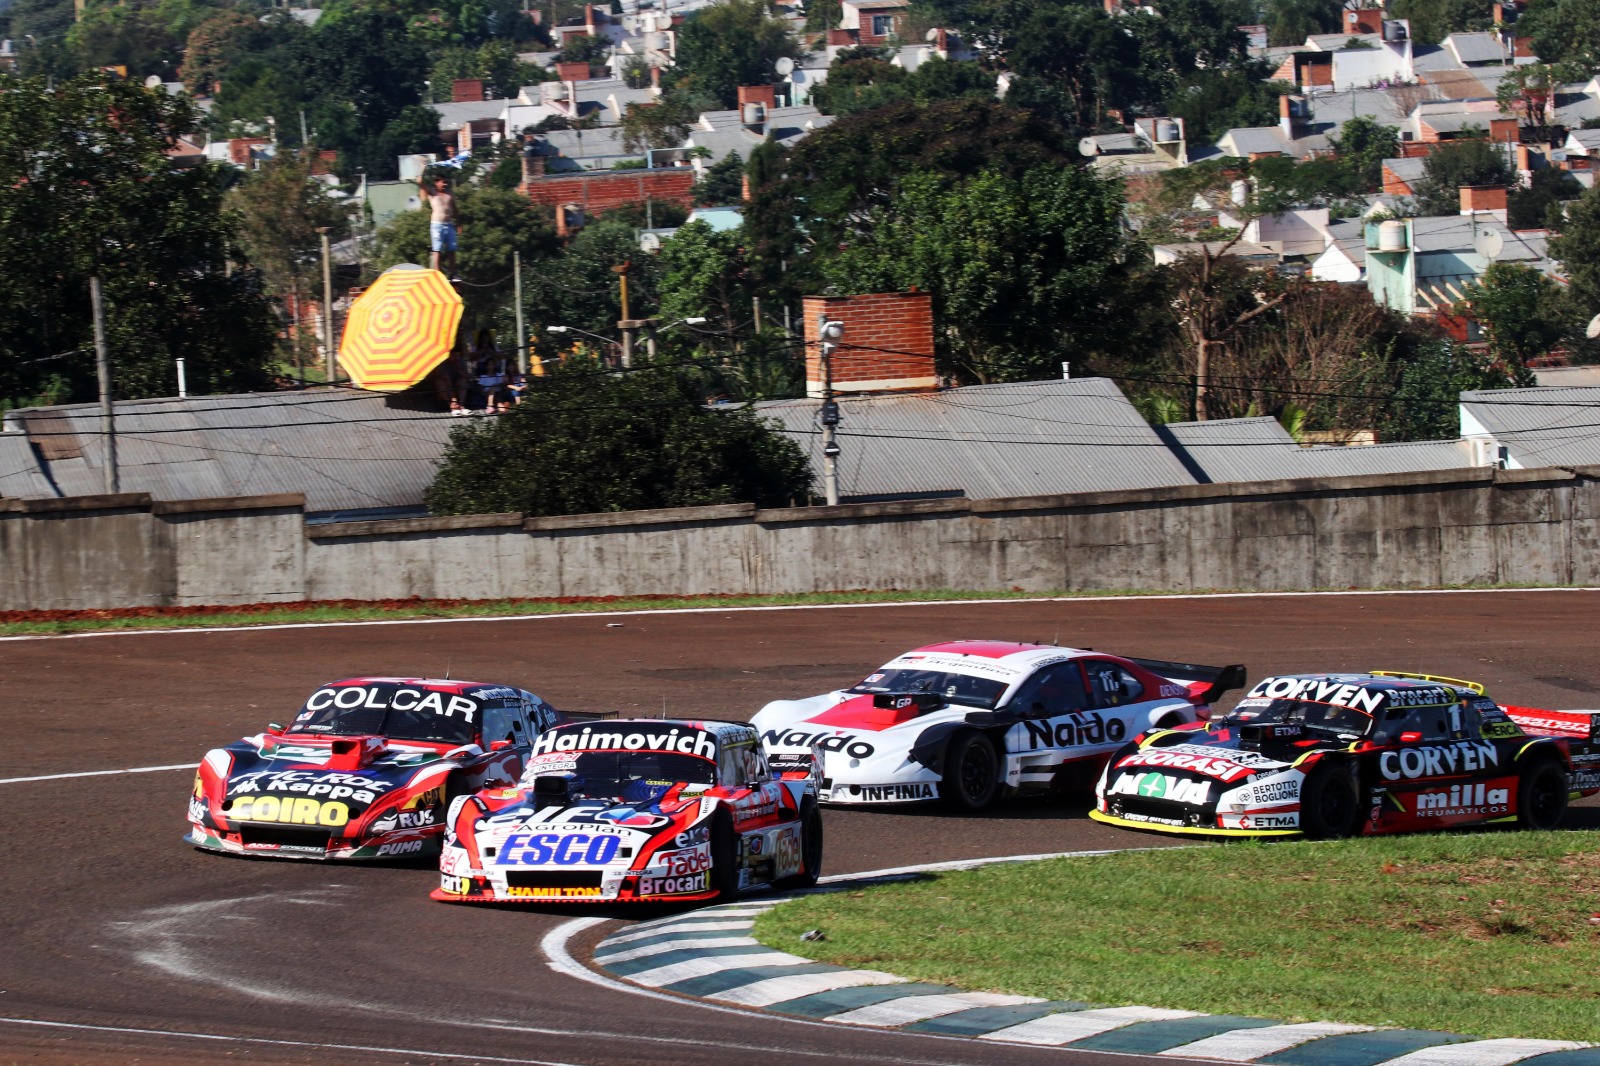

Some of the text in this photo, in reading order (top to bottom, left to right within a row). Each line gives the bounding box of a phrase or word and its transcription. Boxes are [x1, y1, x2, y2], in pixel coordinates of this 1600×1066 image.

[306, 687, 477, 724] COLCAR
[897, 697, 912, 709] GR
[1247, 677, 1385, 714] CORVEN
[1384, 687, 1448, 707] Brocart
[1023, 711, 1126, 750] Naldo
[1274, 726, 1302, 737] ETMA
[531, 727, 716, 760] Haimovich
[760, 728, 875, 759] Naldo
[1118, 751, 1246, 781] FIORASI
[1379, 739, 1499, 781] CORVEN
[267, 780, 376, 804] Kappa
[861, 783, 934, 801] INFINIA
[1253, 780, 1298, 795] BERTOTTO
[1254, 790, 1299, 804] BOGLIONE
[1416, 783, 1509, 809] milla
[230, 796, 349, 827] COIRO
[1254, 816, 1296, 827] ETMA
[1416, 805, 1509, 818] NEUMATICOS
[376, 841, 423, 857] PUMA
[495, 834, 621, 866] ESCO
[507, 886, 602, 897] HAMILTON
[640, 871, 706, 895] Brocart
